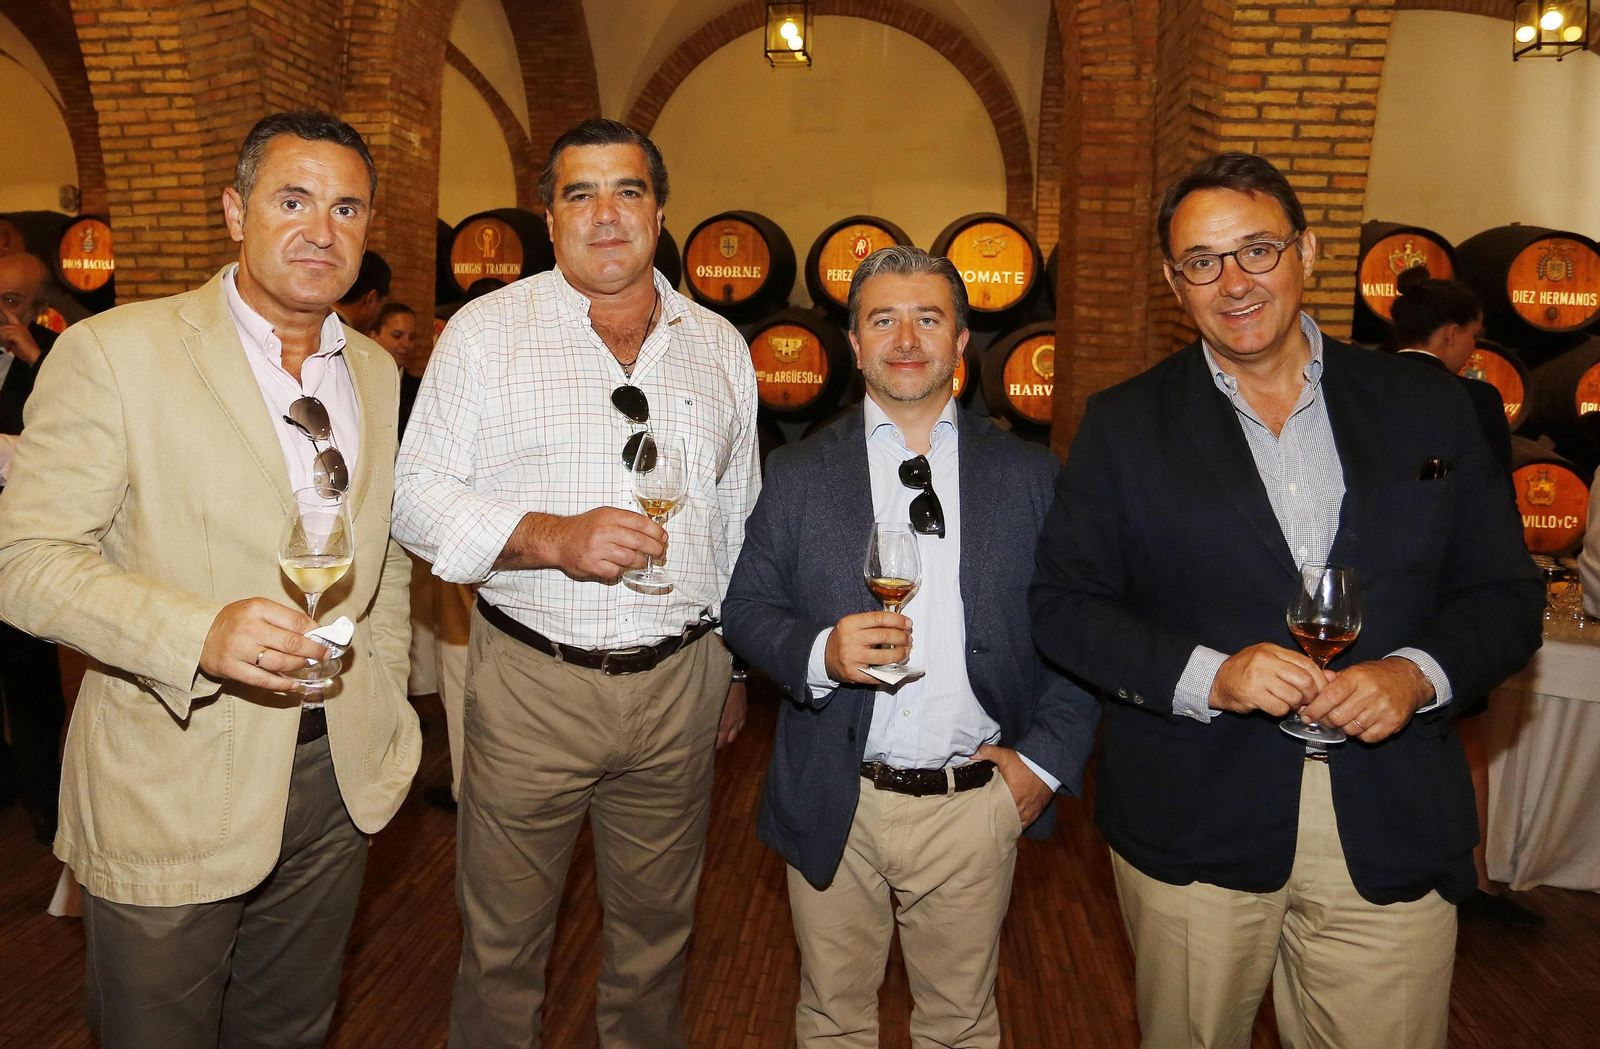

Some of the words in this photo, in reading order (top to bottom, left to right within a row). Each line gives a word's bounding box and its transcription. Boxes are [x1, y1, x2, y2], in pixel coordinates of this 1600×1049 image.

[454, 262, 482, 275] BODEGAS
[485, 263, 521, 275] TRADICION
[696, 265, 761, 278] OSBORNE
[826, 268, 853, 282] PEREZ
[1362, 283, 1395, 297] MANUEL
[1512, 290, 1536, 304] DIEZ
[1539, 291, 1598, 306] HERMANOS
[774, 369, 813, 384] ARGÜESO
[1009, 383, 1054, 396] HARV
